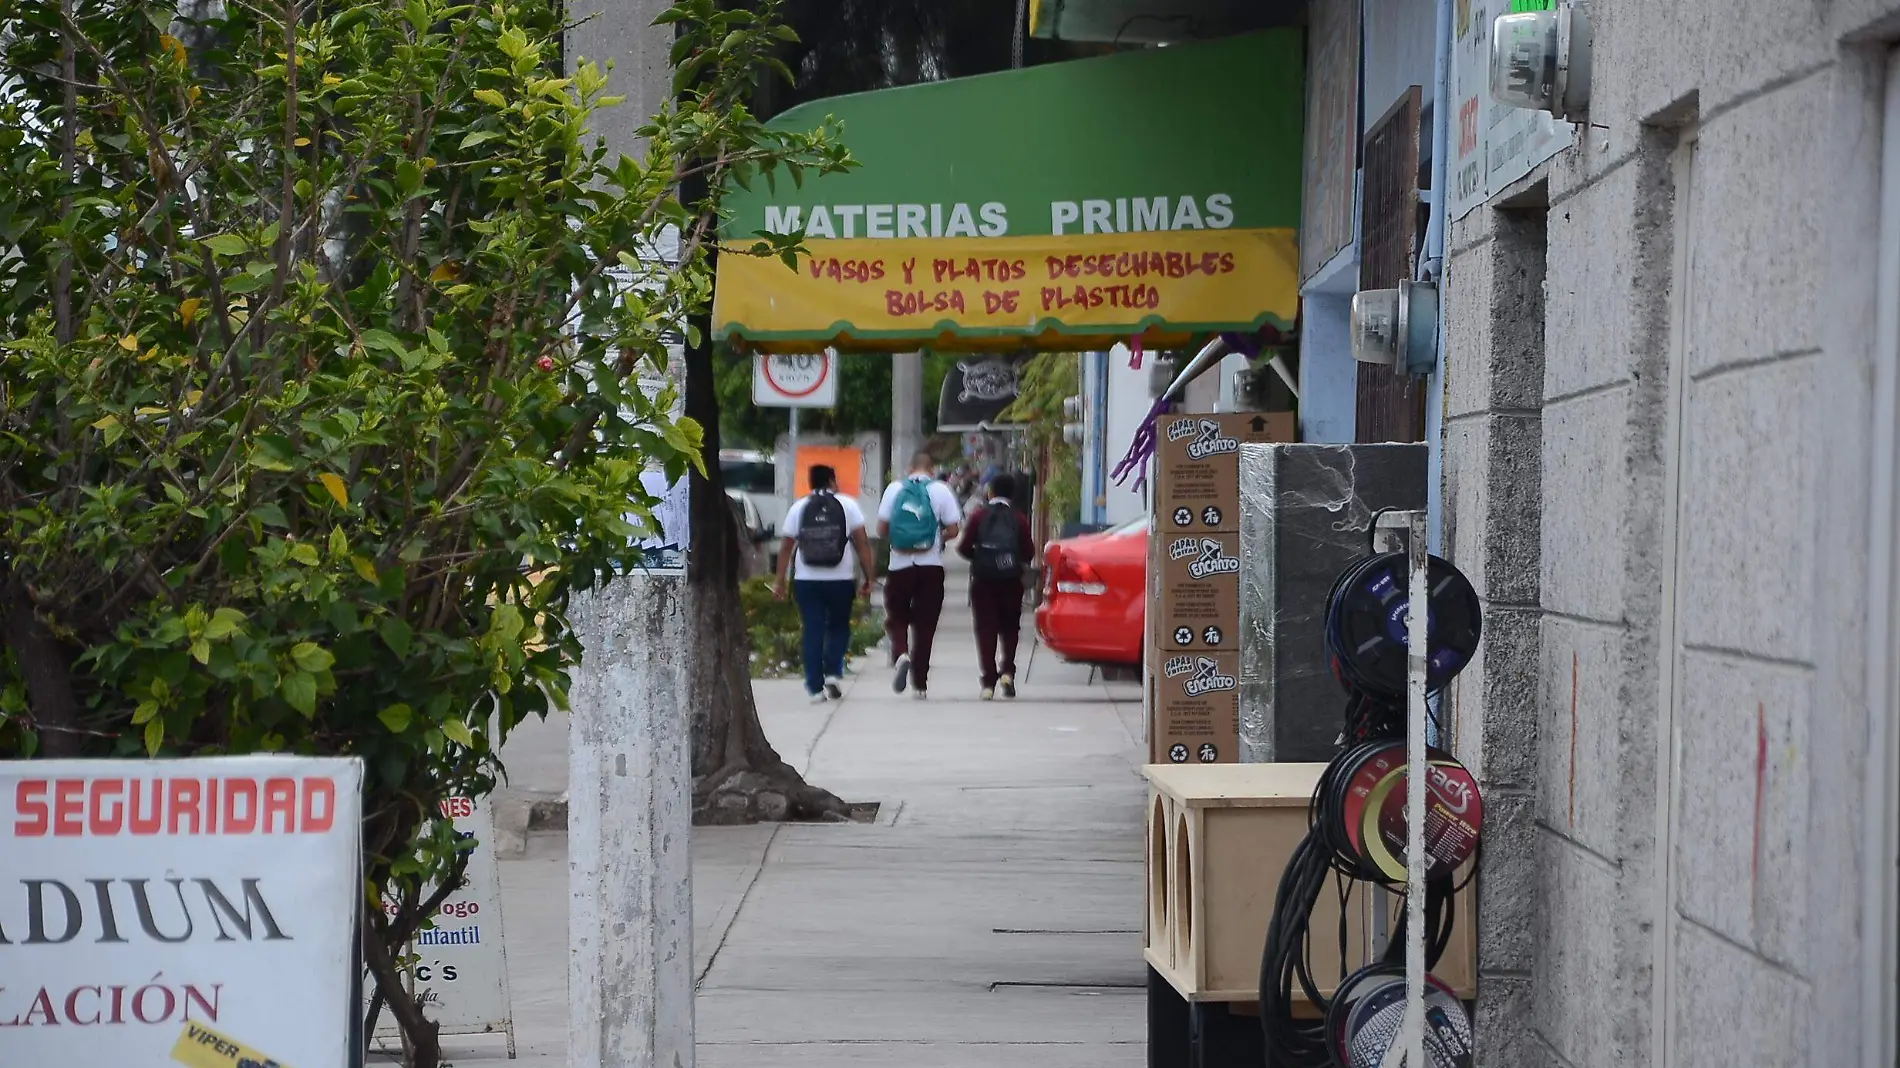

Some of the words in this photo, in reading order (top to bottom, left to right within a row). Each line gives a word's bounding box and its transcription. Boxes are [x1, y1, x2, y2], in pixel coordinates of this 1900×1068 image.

[764, 202, 1008, 239] MATERIAS
[1050, 193, 1234, 236] PRIMAS
[809, 257, 885, 284] VASOS
[902, 256, 915, 285] Y
[932, 256, 1026, 284] PLATOS
[1045, 251, 1235, 280] DESECHABLES
[885, 288, 965, 317] BOLSA
[983, 289, 1020, 315] DE
[1040, 283, 1160, 312] PLASTICO
[1168, 419, 1194, 434] PAPAS
[1170, 538, 1196, 553] PAPAS
[1165, 656, 1192, 671] PAPAS
[1424, 763, 1474, 802] rack
[14, 776, 336, 838] SEGURIDAD
[440, 798, 472, 818] NES
[187, 1025, 240, 1059] VIPER
